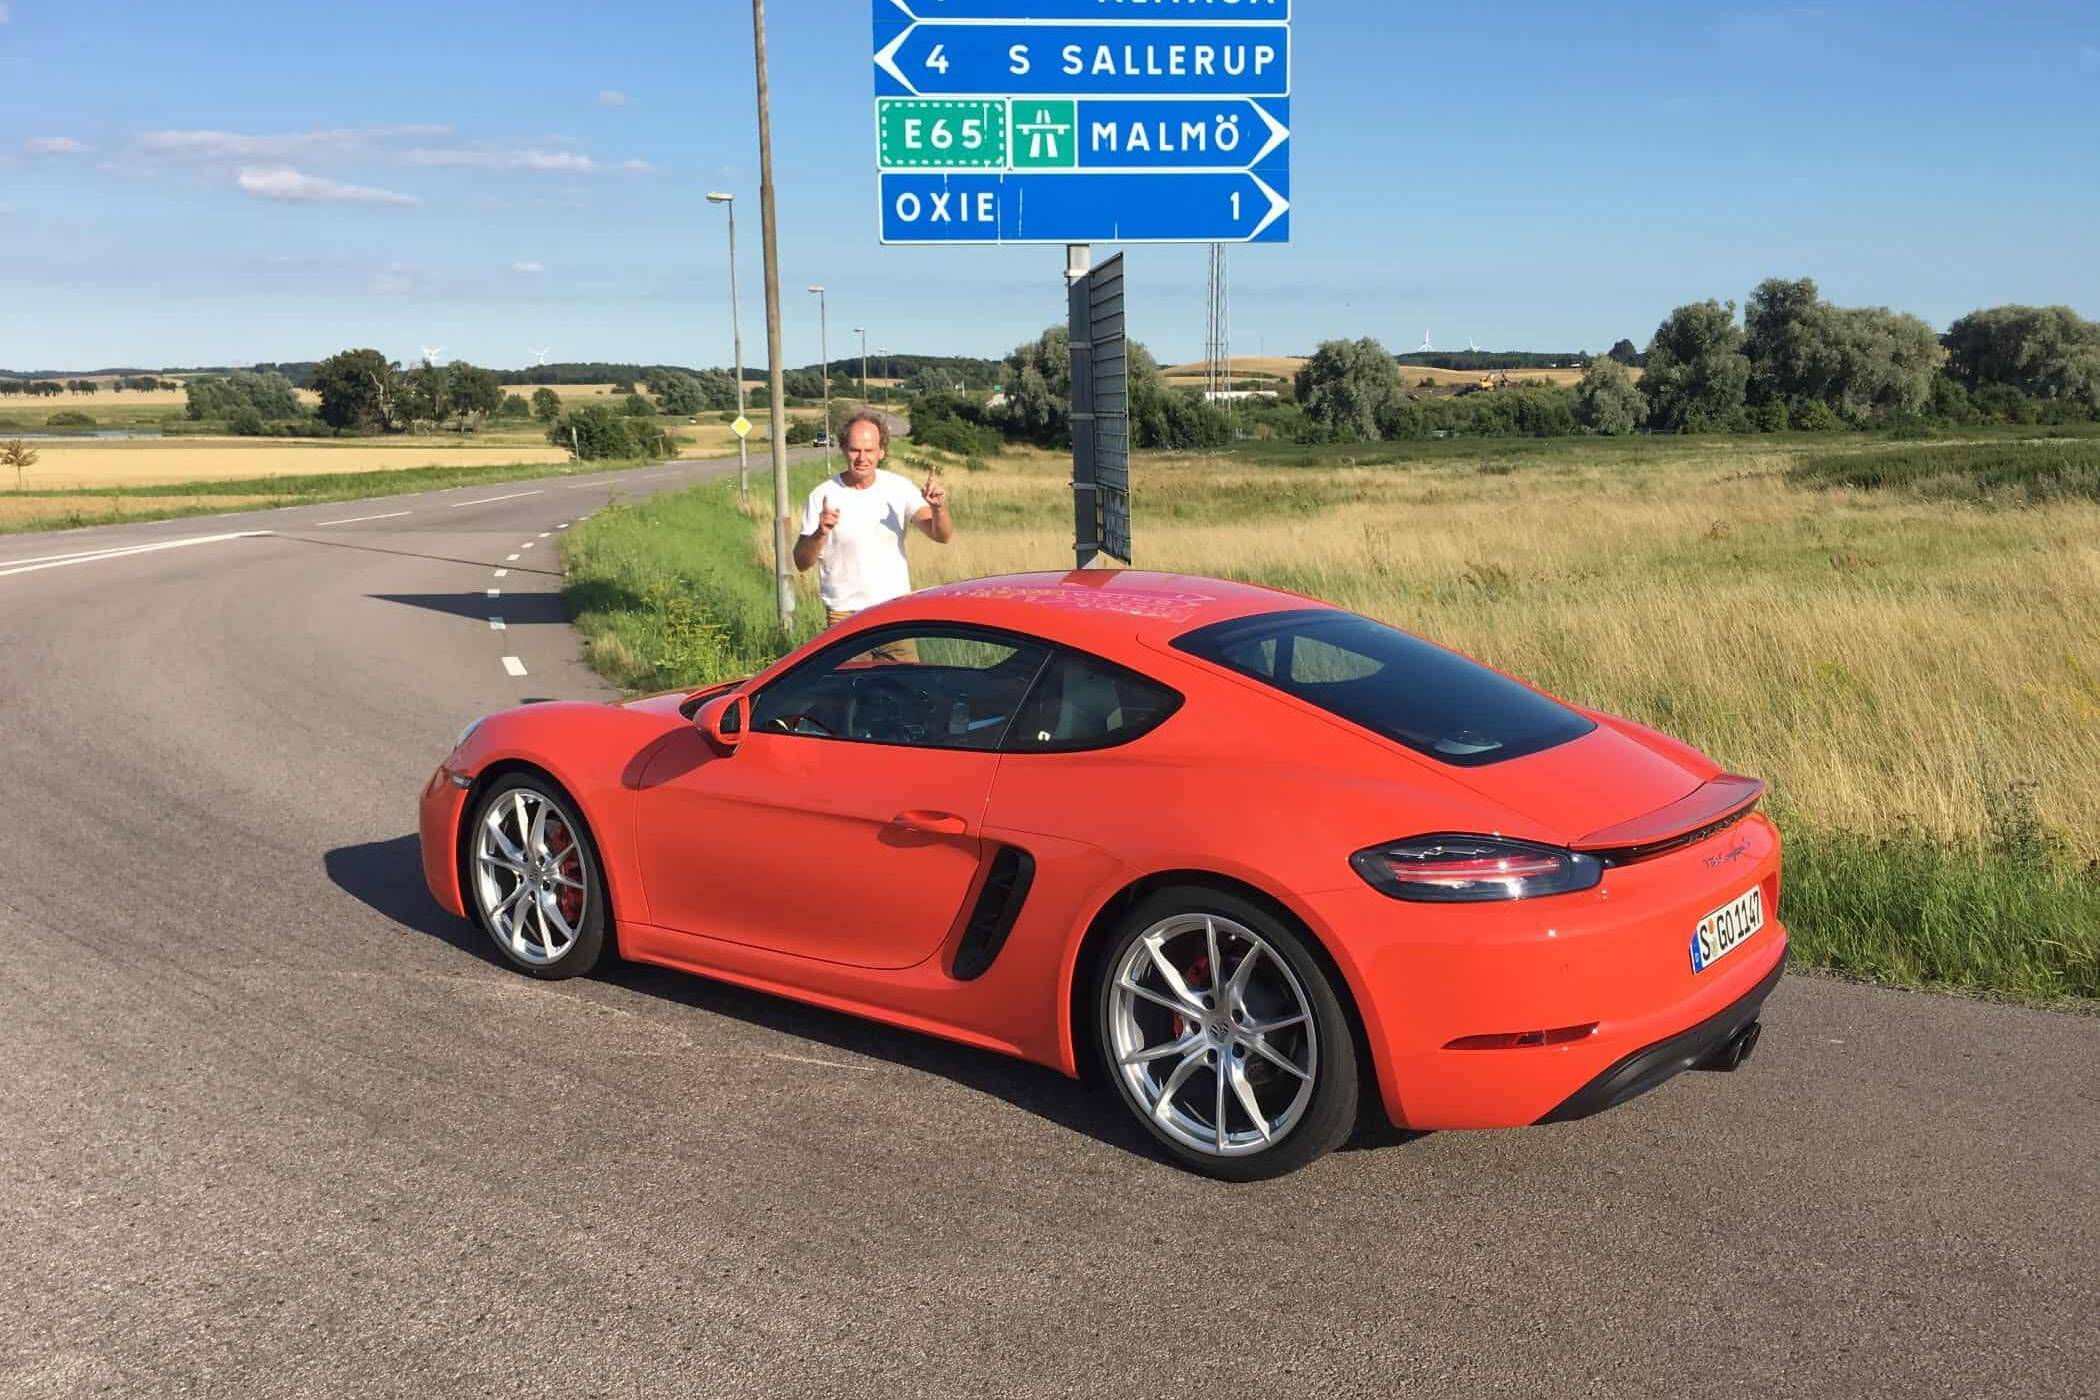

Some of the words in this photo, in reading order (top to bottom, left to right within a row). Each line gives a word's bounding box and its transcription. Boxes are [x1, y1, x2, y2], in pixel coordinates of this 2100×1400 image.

[925, 44, 949, 74] 4
[1009, 45, 1031, 75] S
[1062, 45, 1275, 75] SALLERUP
[904, 118, 982, 149] E65
[1092, 114, 1239, 152] MALMÖ
[895, 192, 994, 222] OXIE
[1230, 191, 1240, 220] 1
